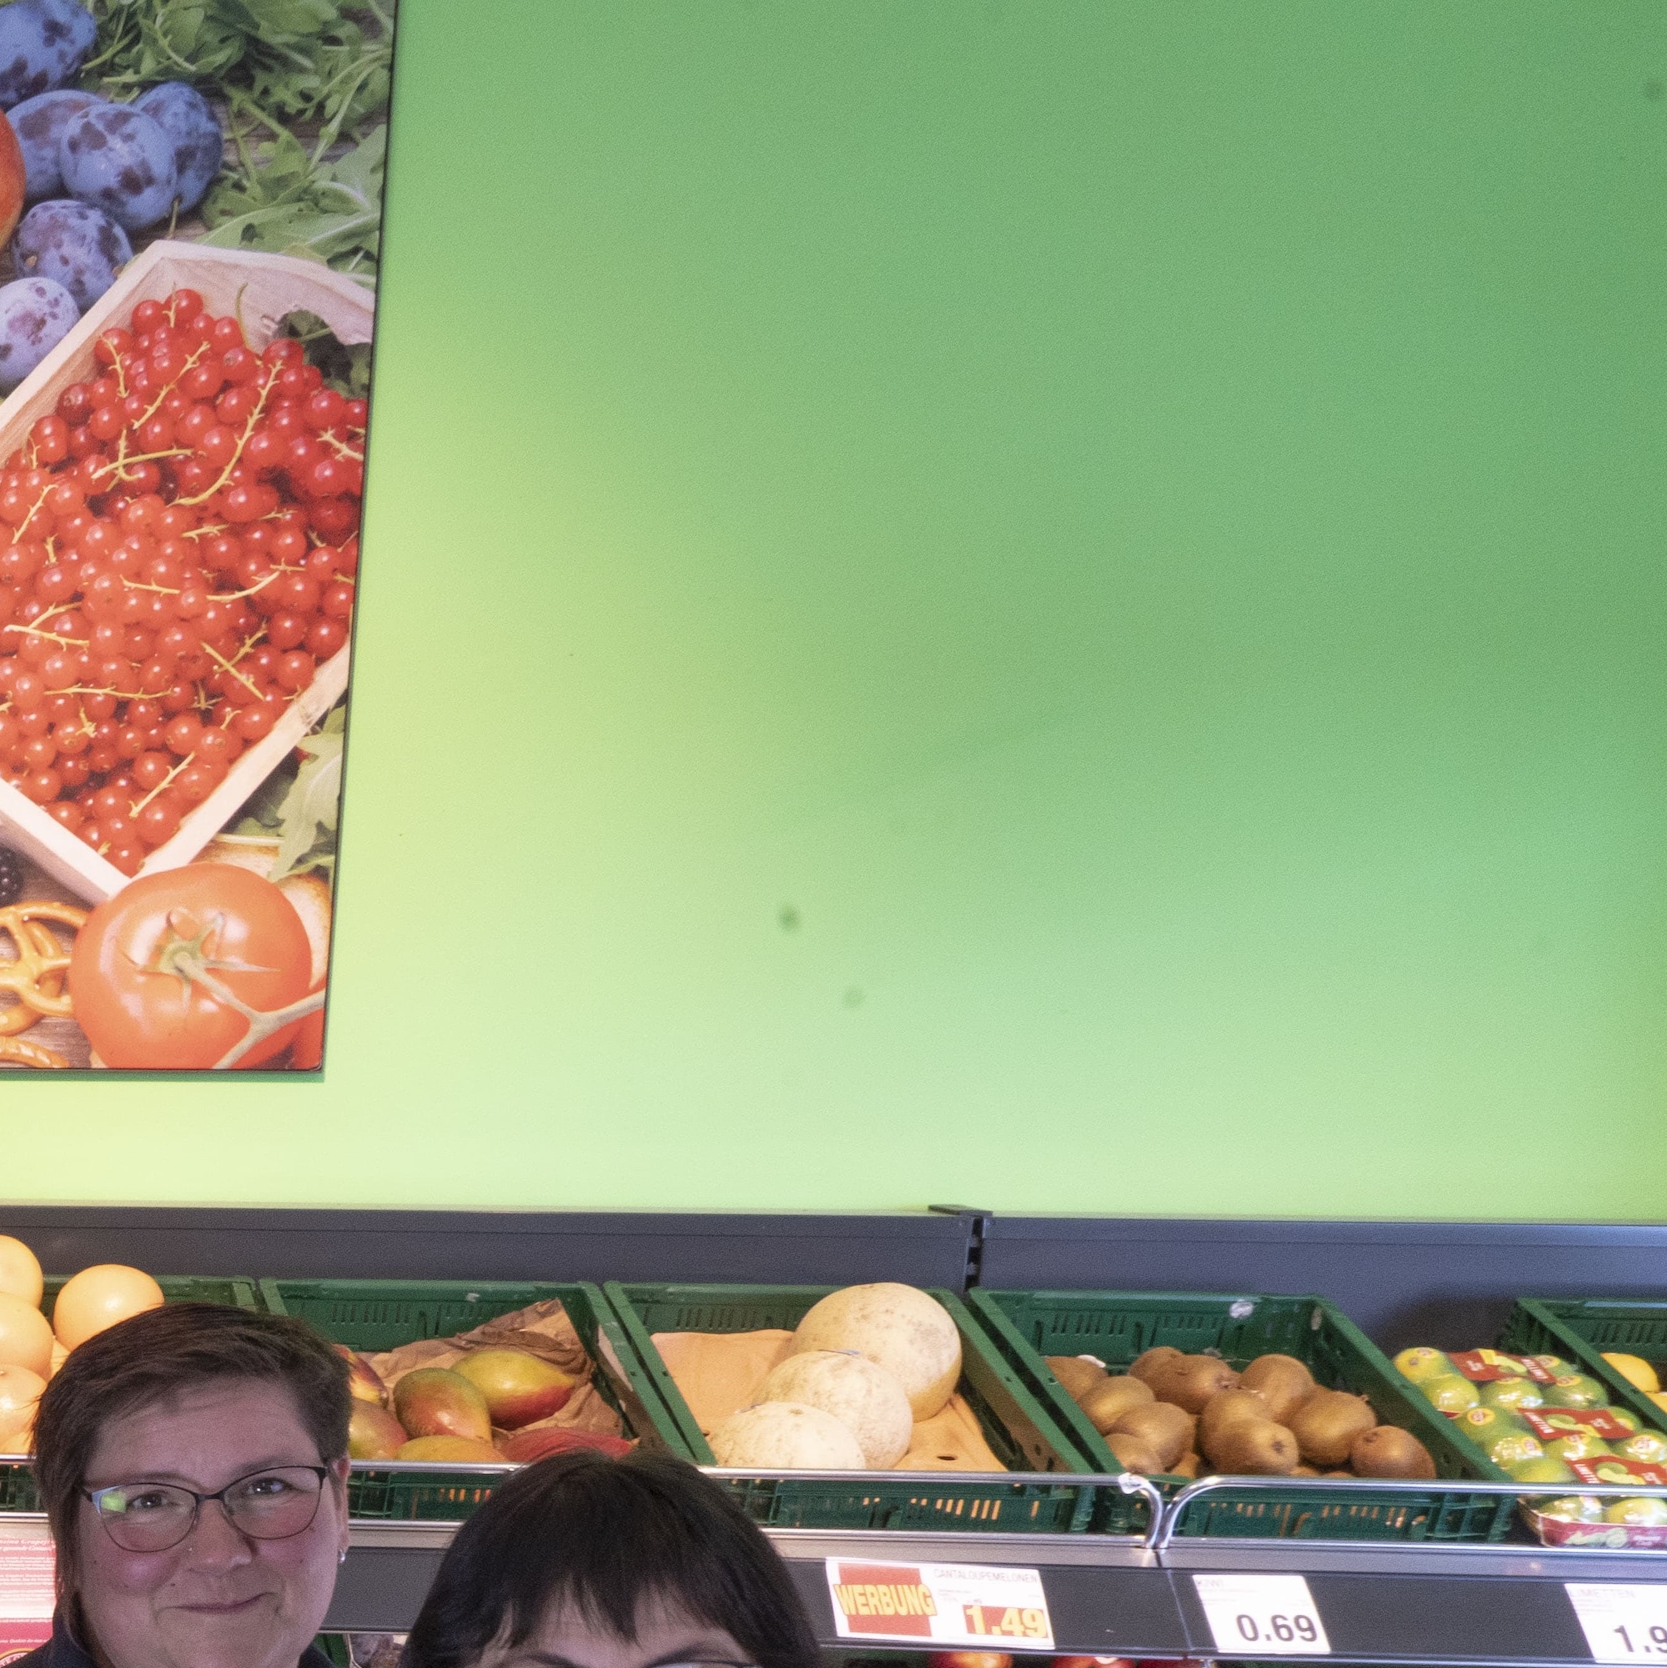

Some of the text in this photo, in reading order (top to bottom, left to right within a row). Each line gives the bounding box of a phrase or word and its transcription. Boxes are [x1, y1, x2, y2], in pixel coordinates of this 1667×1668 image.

[833, 1584, 937, 1616] WERBUNG
[967, 1605, 1048, 1638] 1.49
[1236, 1614, 1317, 1642] 0.69
